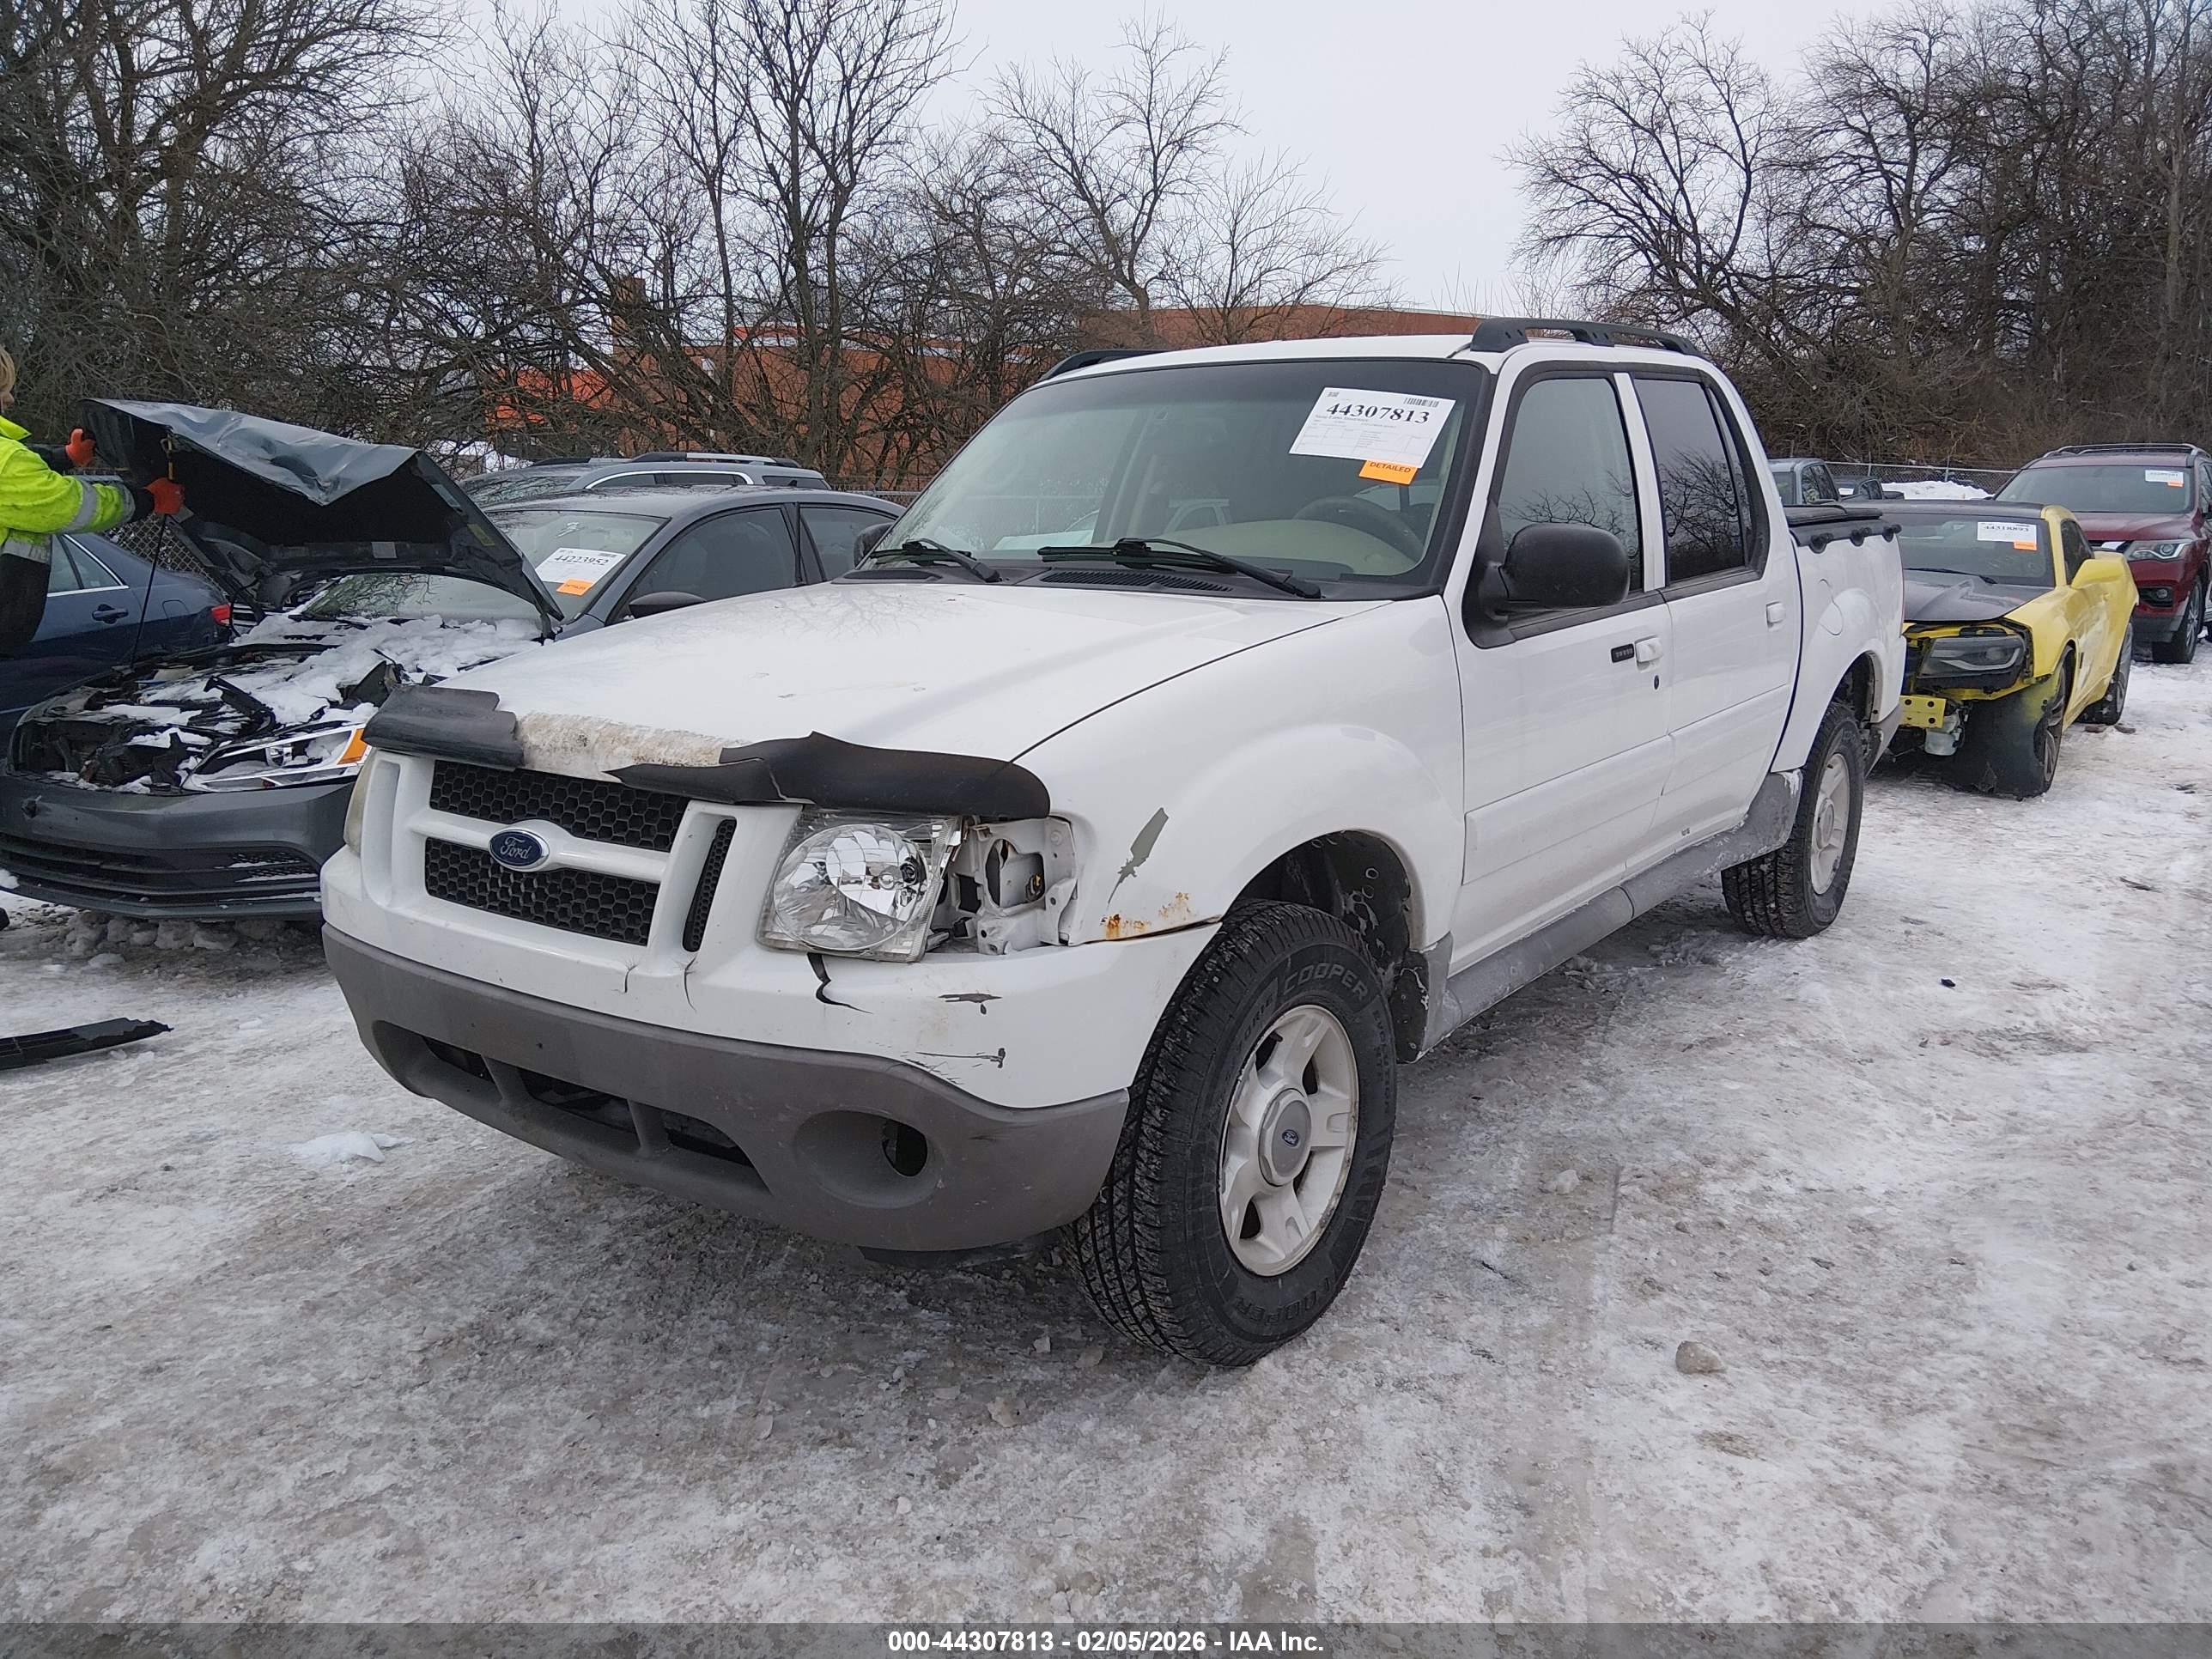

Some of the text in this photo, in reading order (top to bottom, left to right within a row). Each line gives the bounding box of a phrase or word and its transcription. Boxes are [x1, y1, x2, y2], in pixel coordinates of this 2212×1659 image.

[1326, 403, 1431, 424] 44307813
[1369, 461, 1412, 474] DETAILED
[554, 555, 610, 566] 44223952
[500, 836, 532, 860] Ford
[1283, 963, 1369, 1001] COOPER
